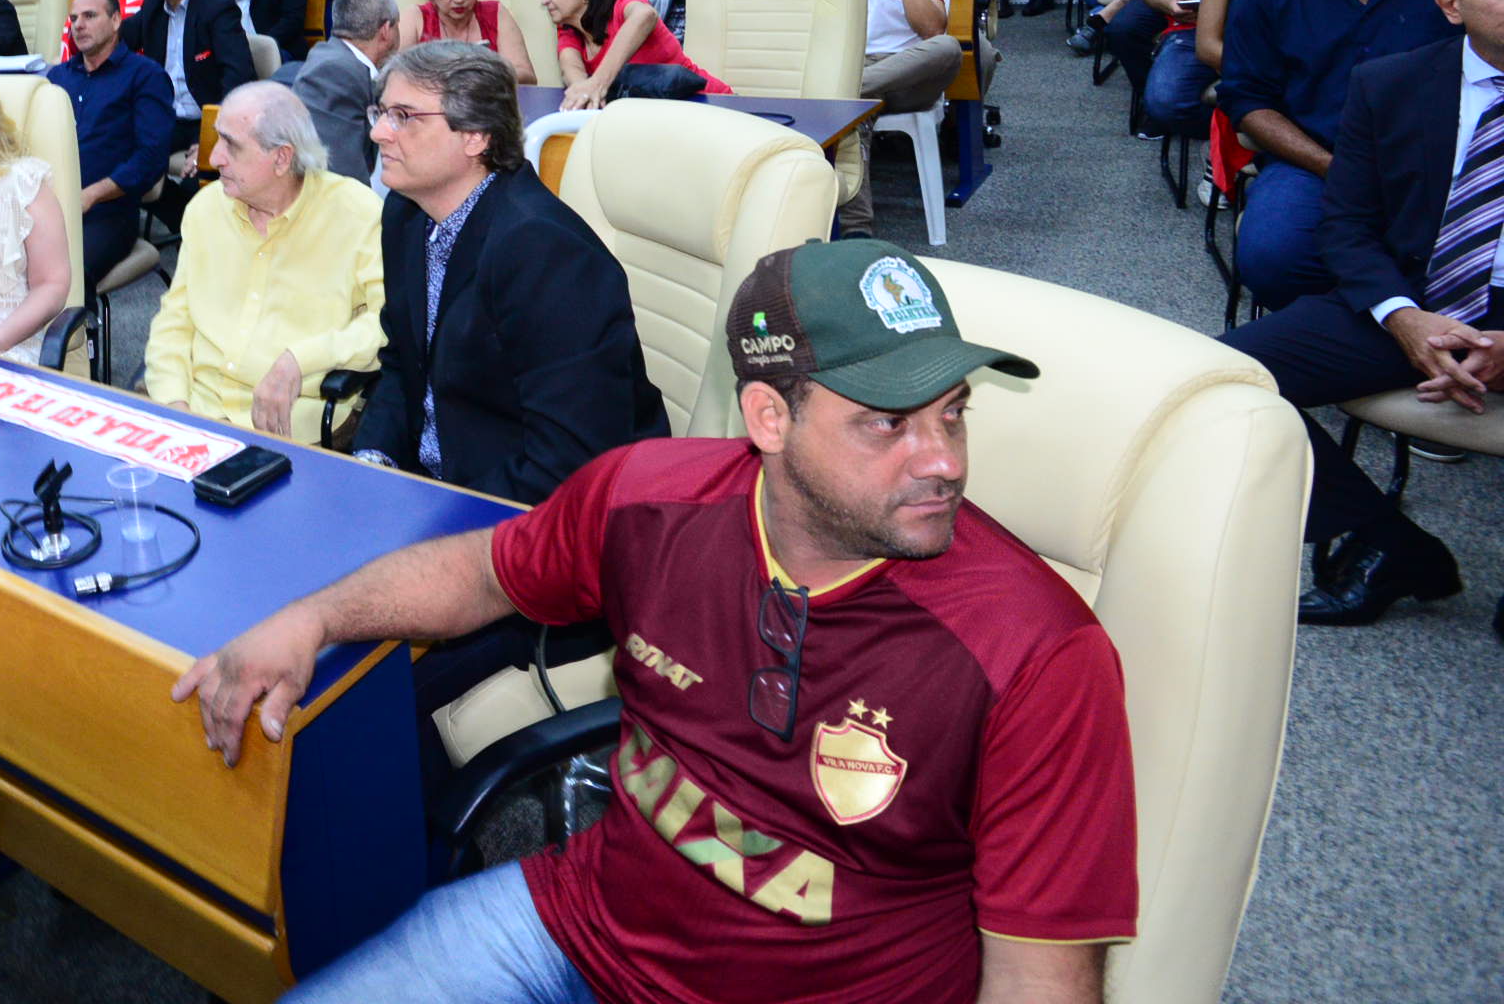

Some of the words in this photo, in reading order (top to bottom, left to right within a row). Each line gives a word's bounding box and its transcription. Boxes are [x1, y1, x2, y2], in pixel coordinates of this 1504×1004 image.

[740, 334, 796, 354] CAMPO
[822, 756, 846, 768] VILA
[847, 761, 875, 773] NOVA
[617, 723, 835, 925] CAIXA
